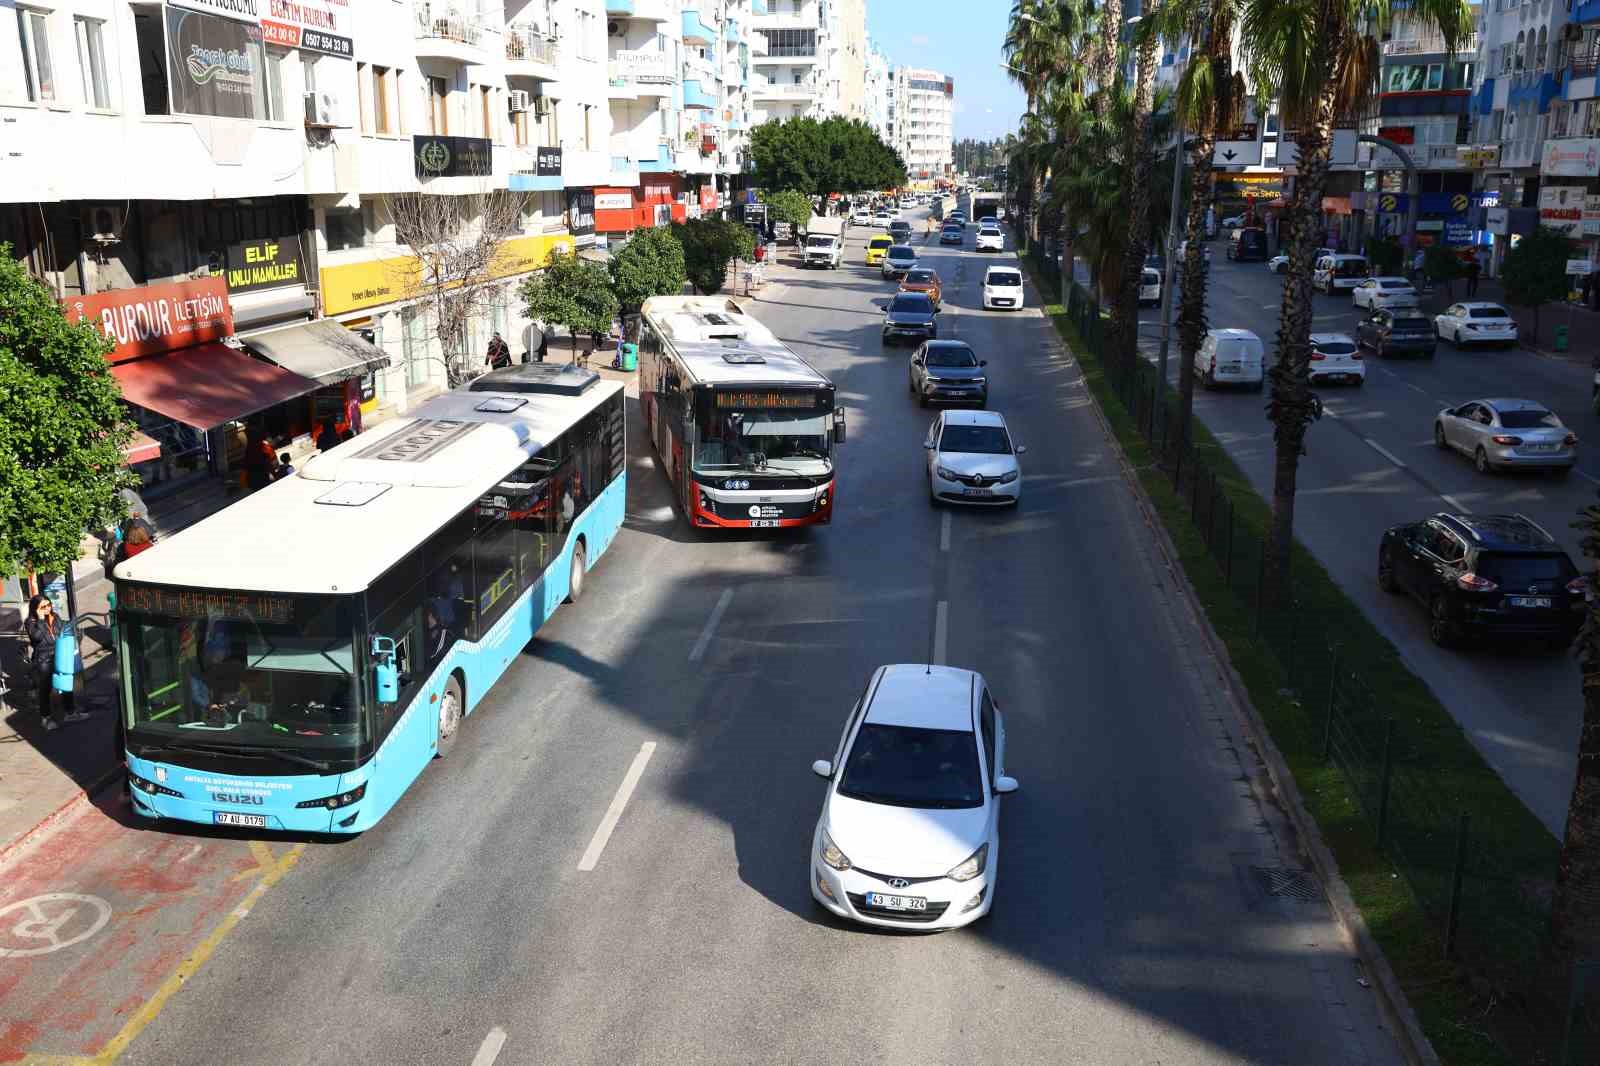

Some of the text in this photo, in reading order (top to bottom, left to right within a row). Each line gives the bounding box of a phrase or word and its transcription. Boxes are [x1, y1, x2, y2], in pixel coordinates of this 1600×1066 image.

[245, 242, 279, 263] ELİF
[101, 298, 173, 345] BURDUR
[174, 292, 224, 321] İLETİŞİM
[212, 792, 264, 805] ISUZU
[218, 815, 228, 823] 07
[230, 816, 240, 824] AU
